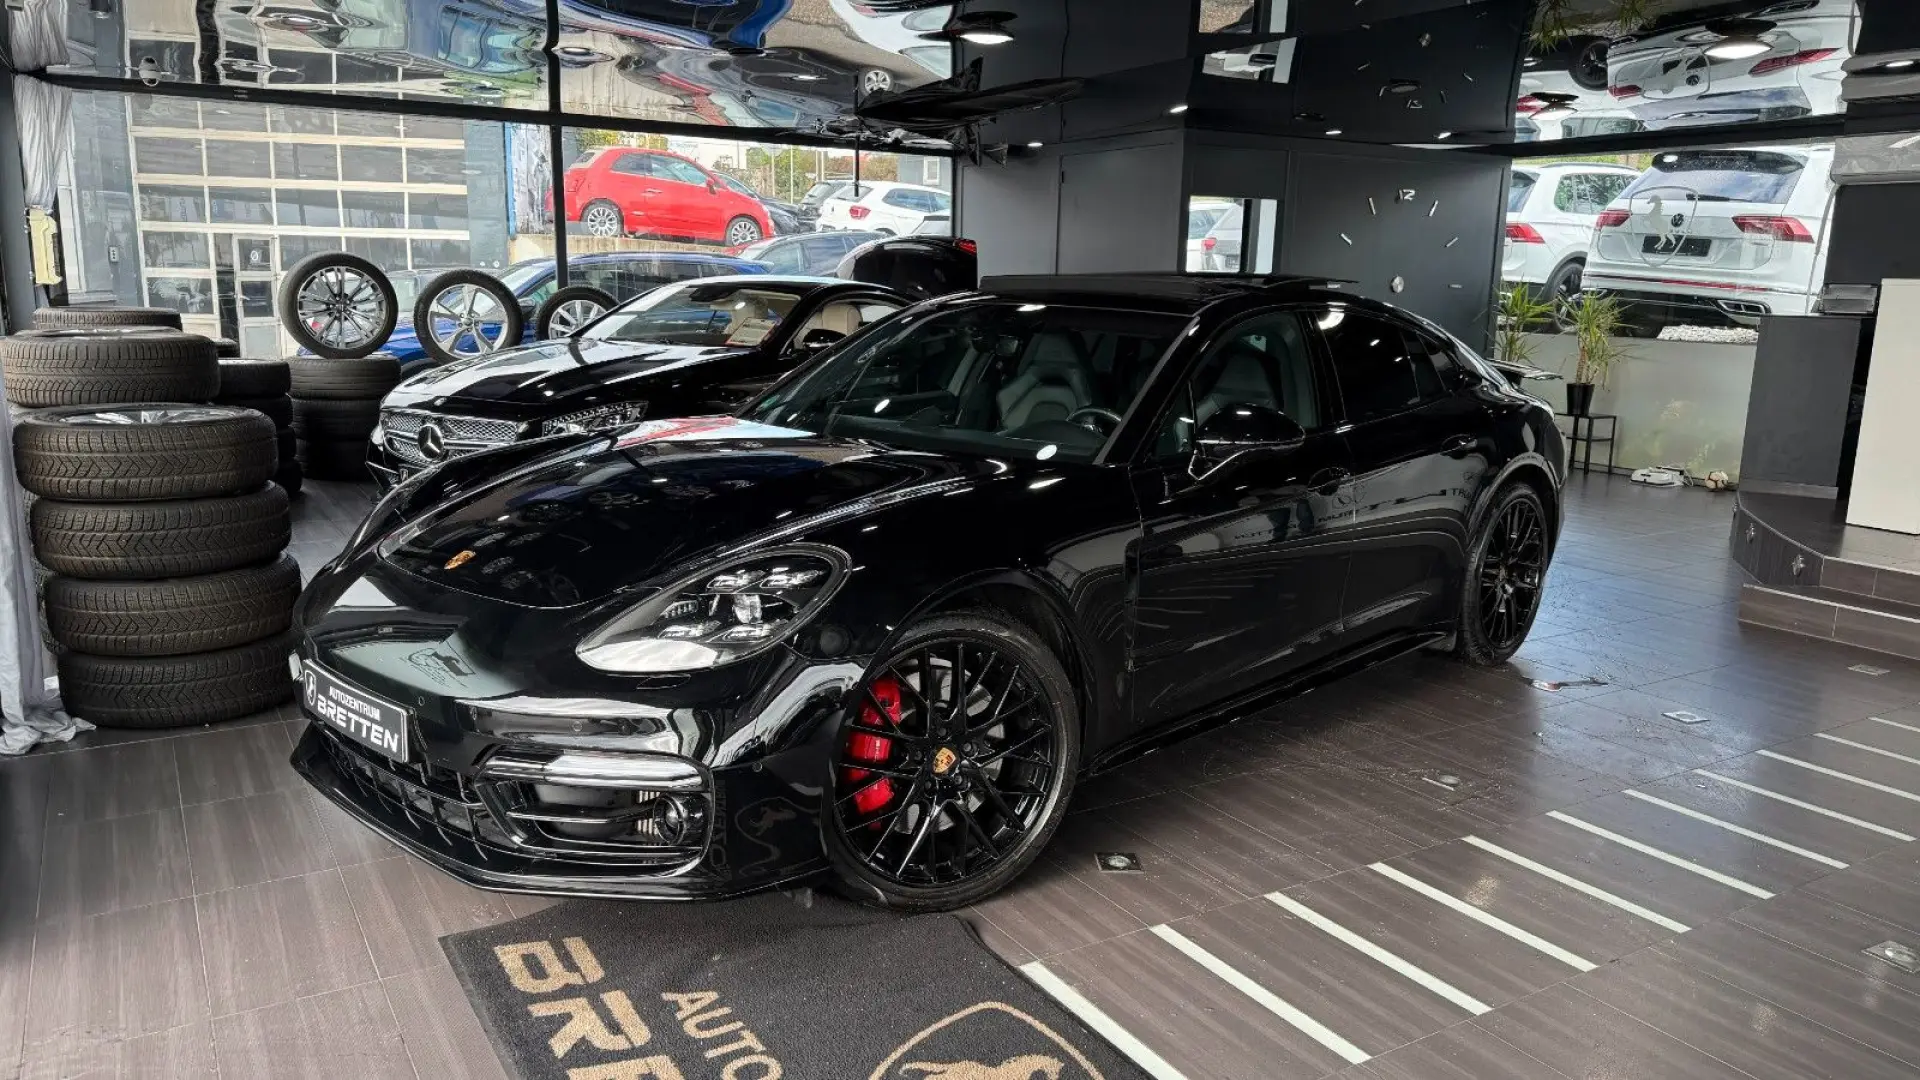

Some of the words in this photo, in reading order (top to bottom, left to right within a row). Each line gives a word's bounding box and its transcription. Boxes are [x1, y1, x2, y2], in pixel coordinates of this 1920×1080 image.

[1398, 189, 1415, 200] 12
[330, 686, 380, 721] AUTOZENTRUM
[317, 693, 399, 753] BRETTEN
